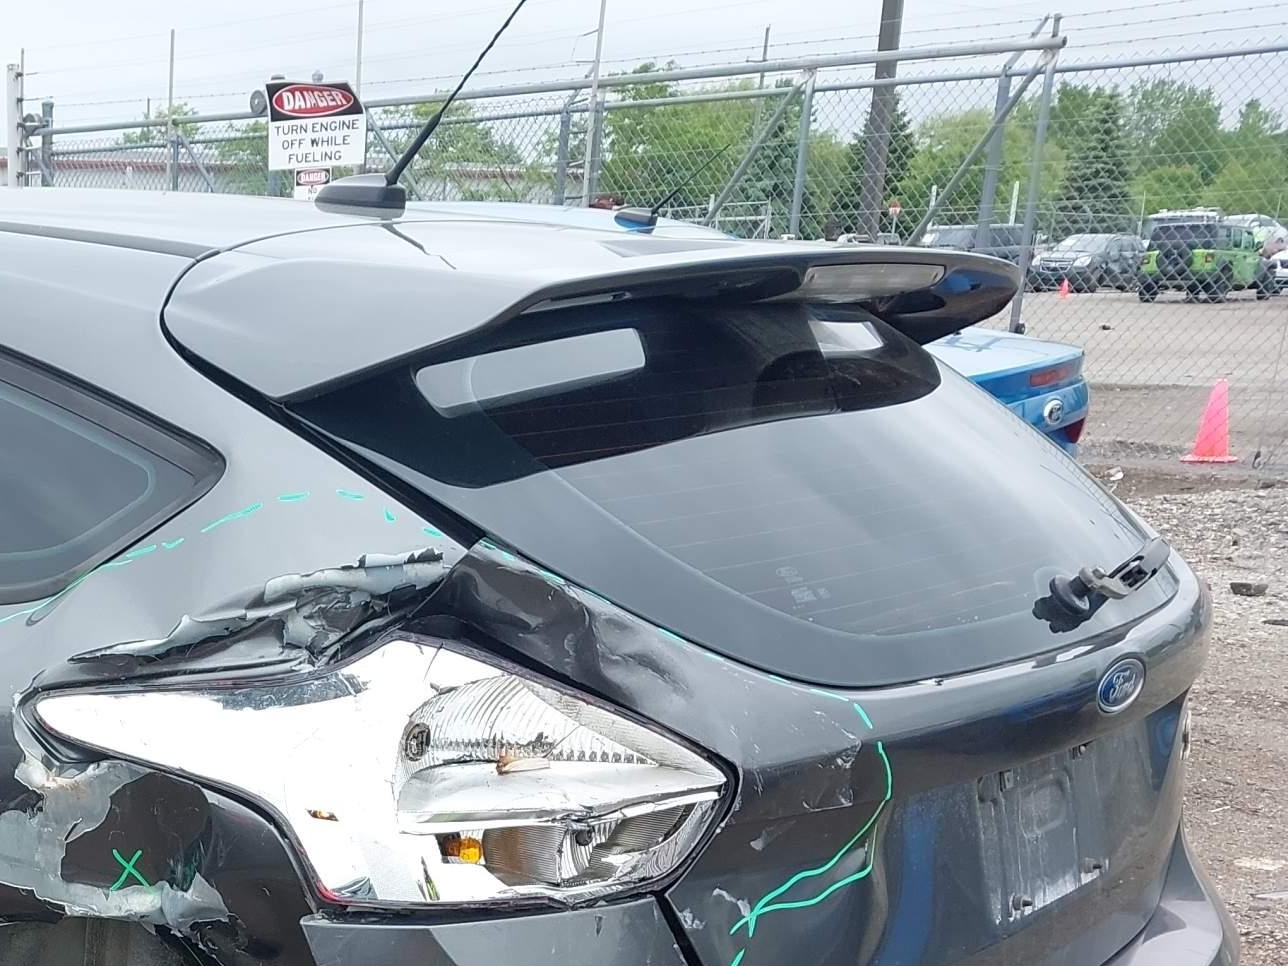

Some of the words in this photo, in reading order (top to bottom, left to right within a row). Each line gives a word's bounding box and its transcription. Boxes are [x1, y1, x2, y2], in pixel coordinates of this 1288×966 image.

[282, 90, 348, 111] DANGER
[274, 123, 308, 136] TURN
[311, 118, 360, 133] ENGINE
[281, 137, 304, 150] OFF
[310, 135, 351, 148] WHILE
[288, 150, 343, 165] FUELING
[300, 172, 326, 182] DANGER
